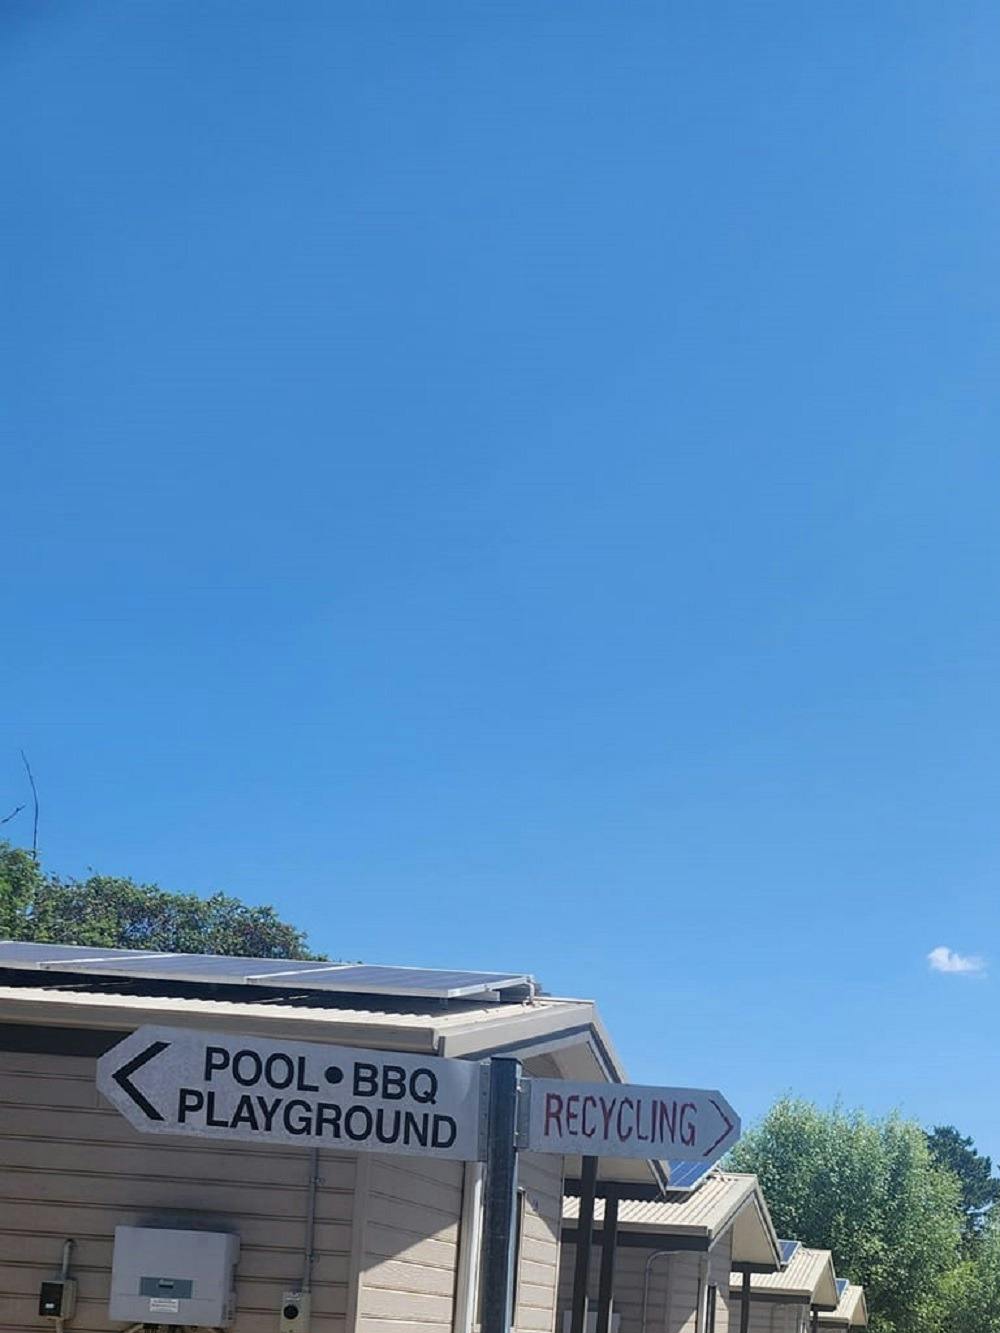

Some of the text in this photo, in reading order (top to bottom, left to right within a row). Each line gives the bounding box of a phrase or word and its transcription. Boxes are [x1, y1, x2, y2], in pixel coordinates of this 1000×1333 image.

[204, 1046, 438, 1105] POOL BBQ
[177, 1088, 457, 1148] PLAYGROUND
[544, 1092, 698, 1147] RECYCLING
